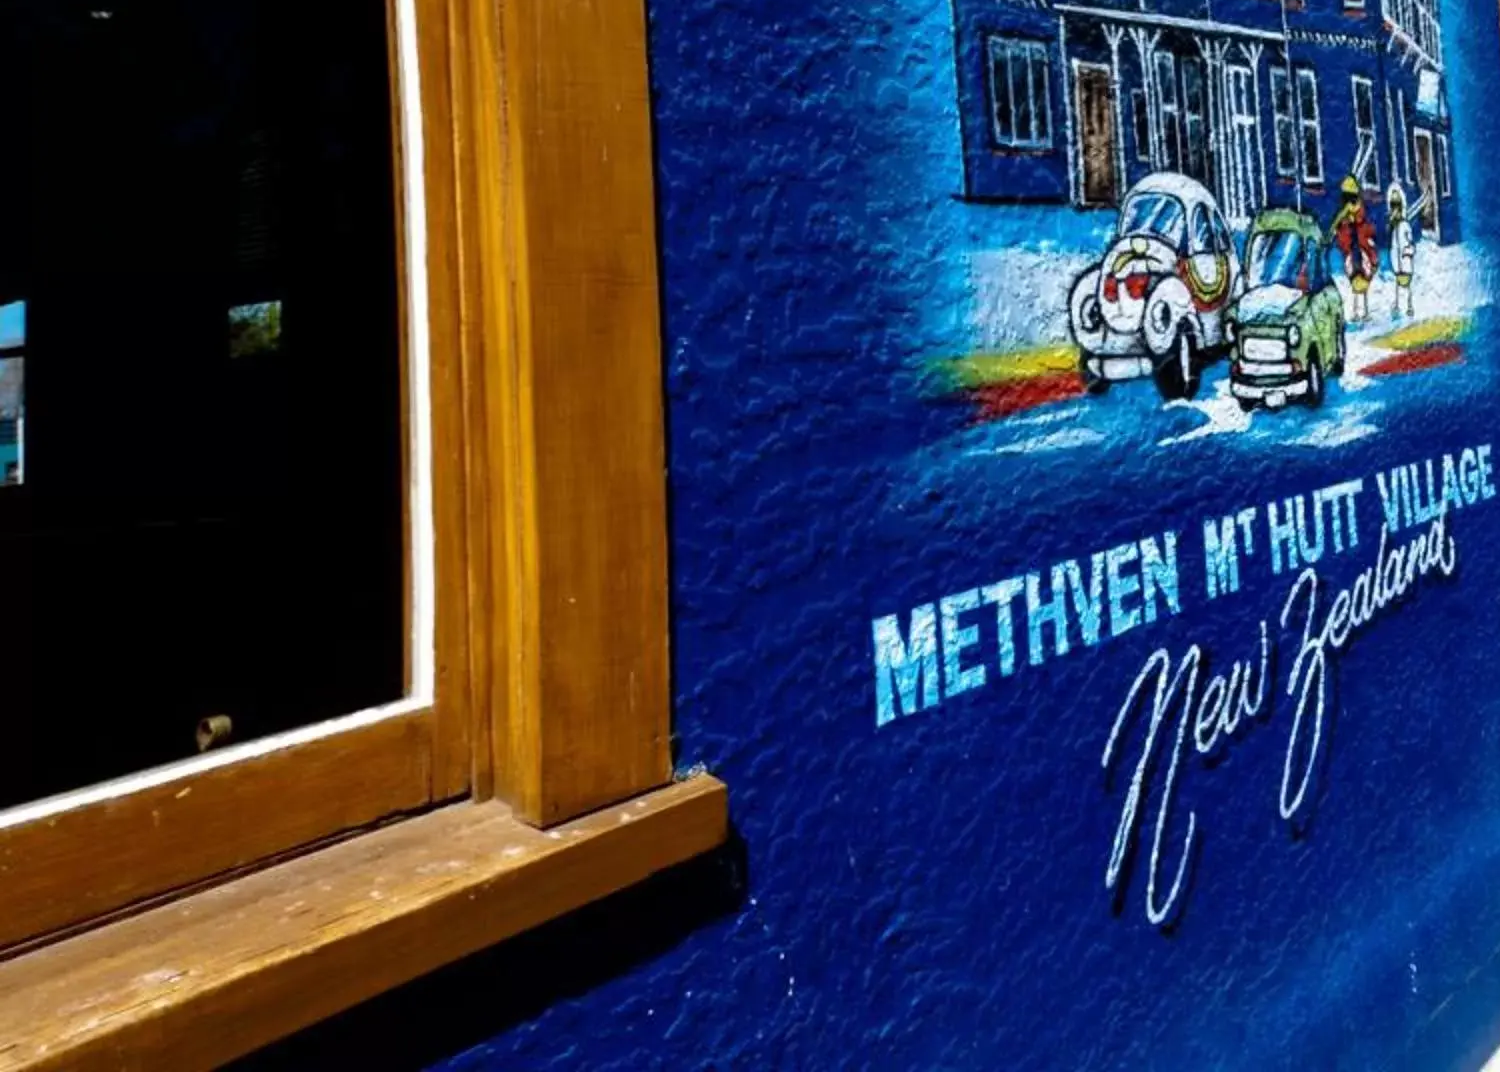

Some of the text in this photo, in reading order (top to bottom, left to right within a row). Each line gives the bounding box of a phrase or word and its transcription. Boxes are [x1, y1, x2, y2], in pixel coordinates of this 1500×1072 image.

[872, 531, 1180, 727] METHVEN
[1267, 479, 1363, 575] HUTT
[1376, 444, 1496, 532] VILLAGE
[1102, 502, 1455, 924] New Zealand
